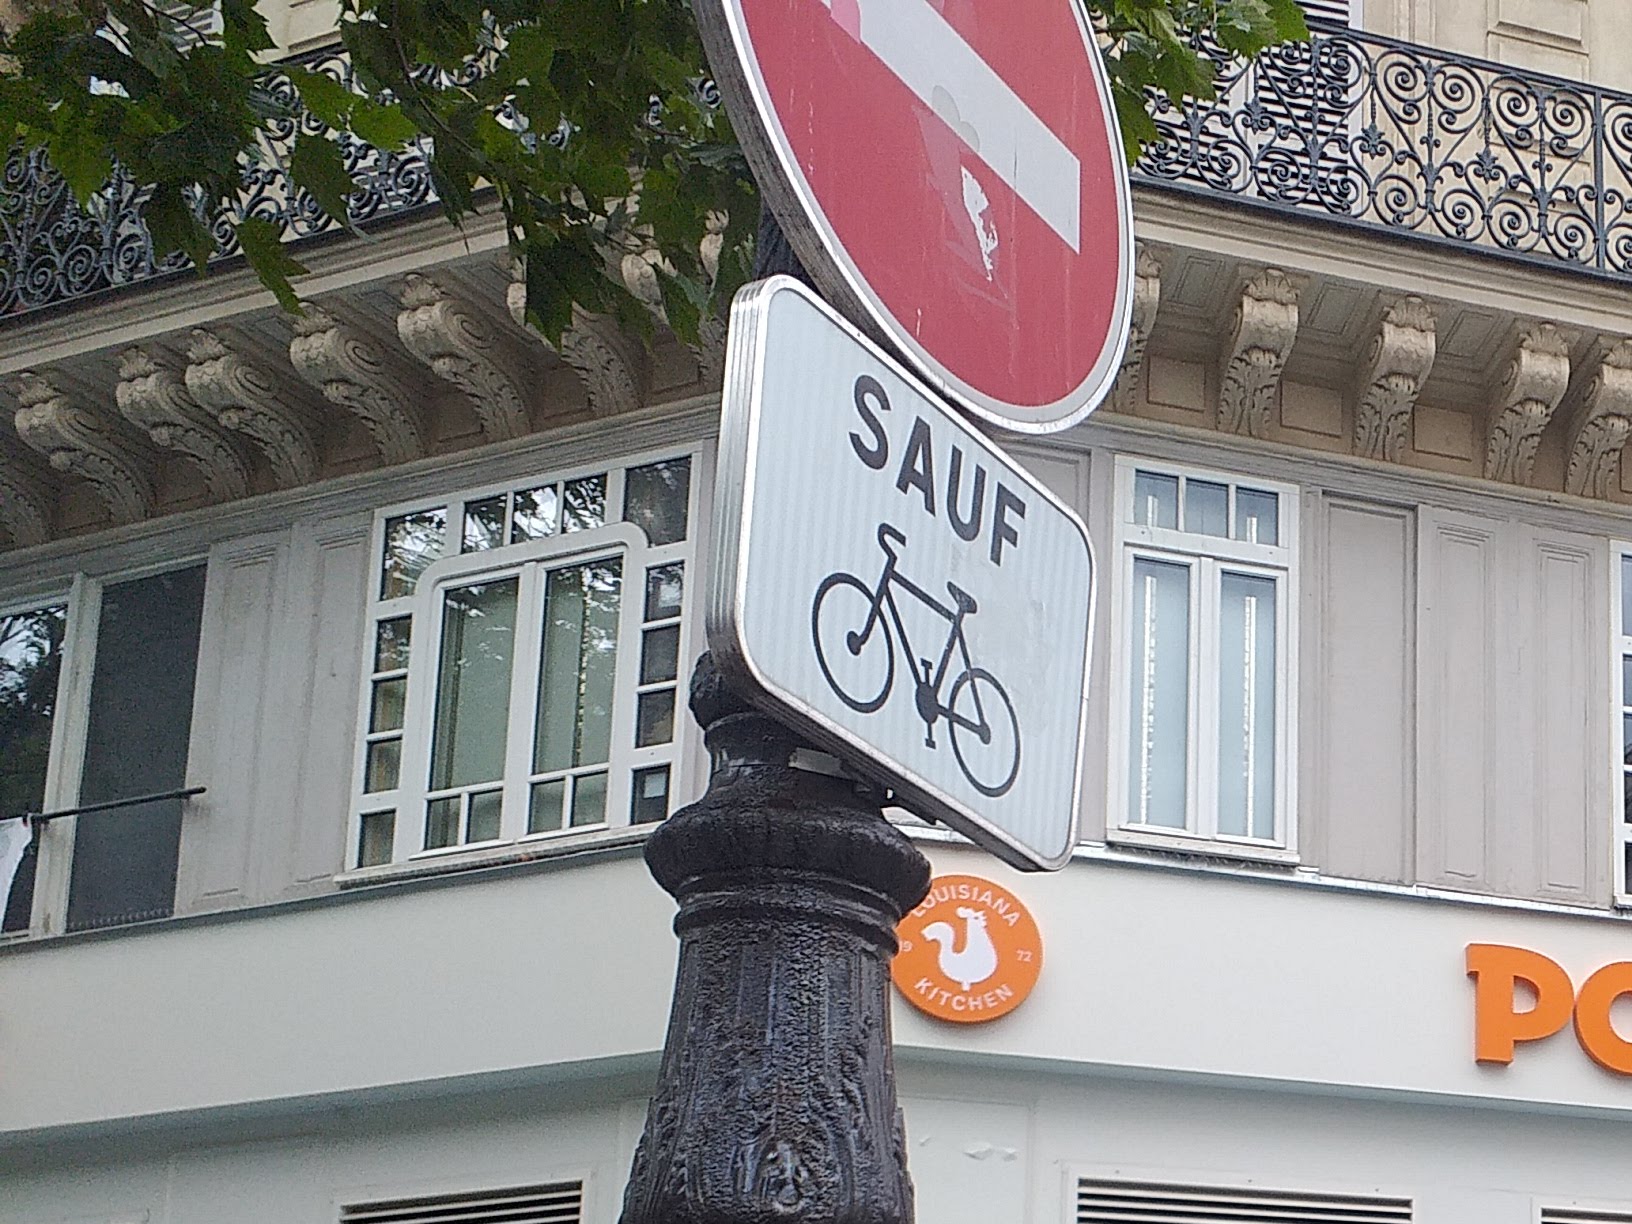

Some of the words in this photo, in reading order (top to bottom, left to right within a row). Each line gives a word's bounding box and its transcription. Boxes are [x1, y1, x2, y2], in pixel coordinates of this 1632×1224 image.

[849, 374, 1026, 567] SAUF
[911, 884, 1021, 927] LOUISIANA
[1016, 949, 1033, 962] 72
[914, 977, 1014, 1011] KITCHEN
